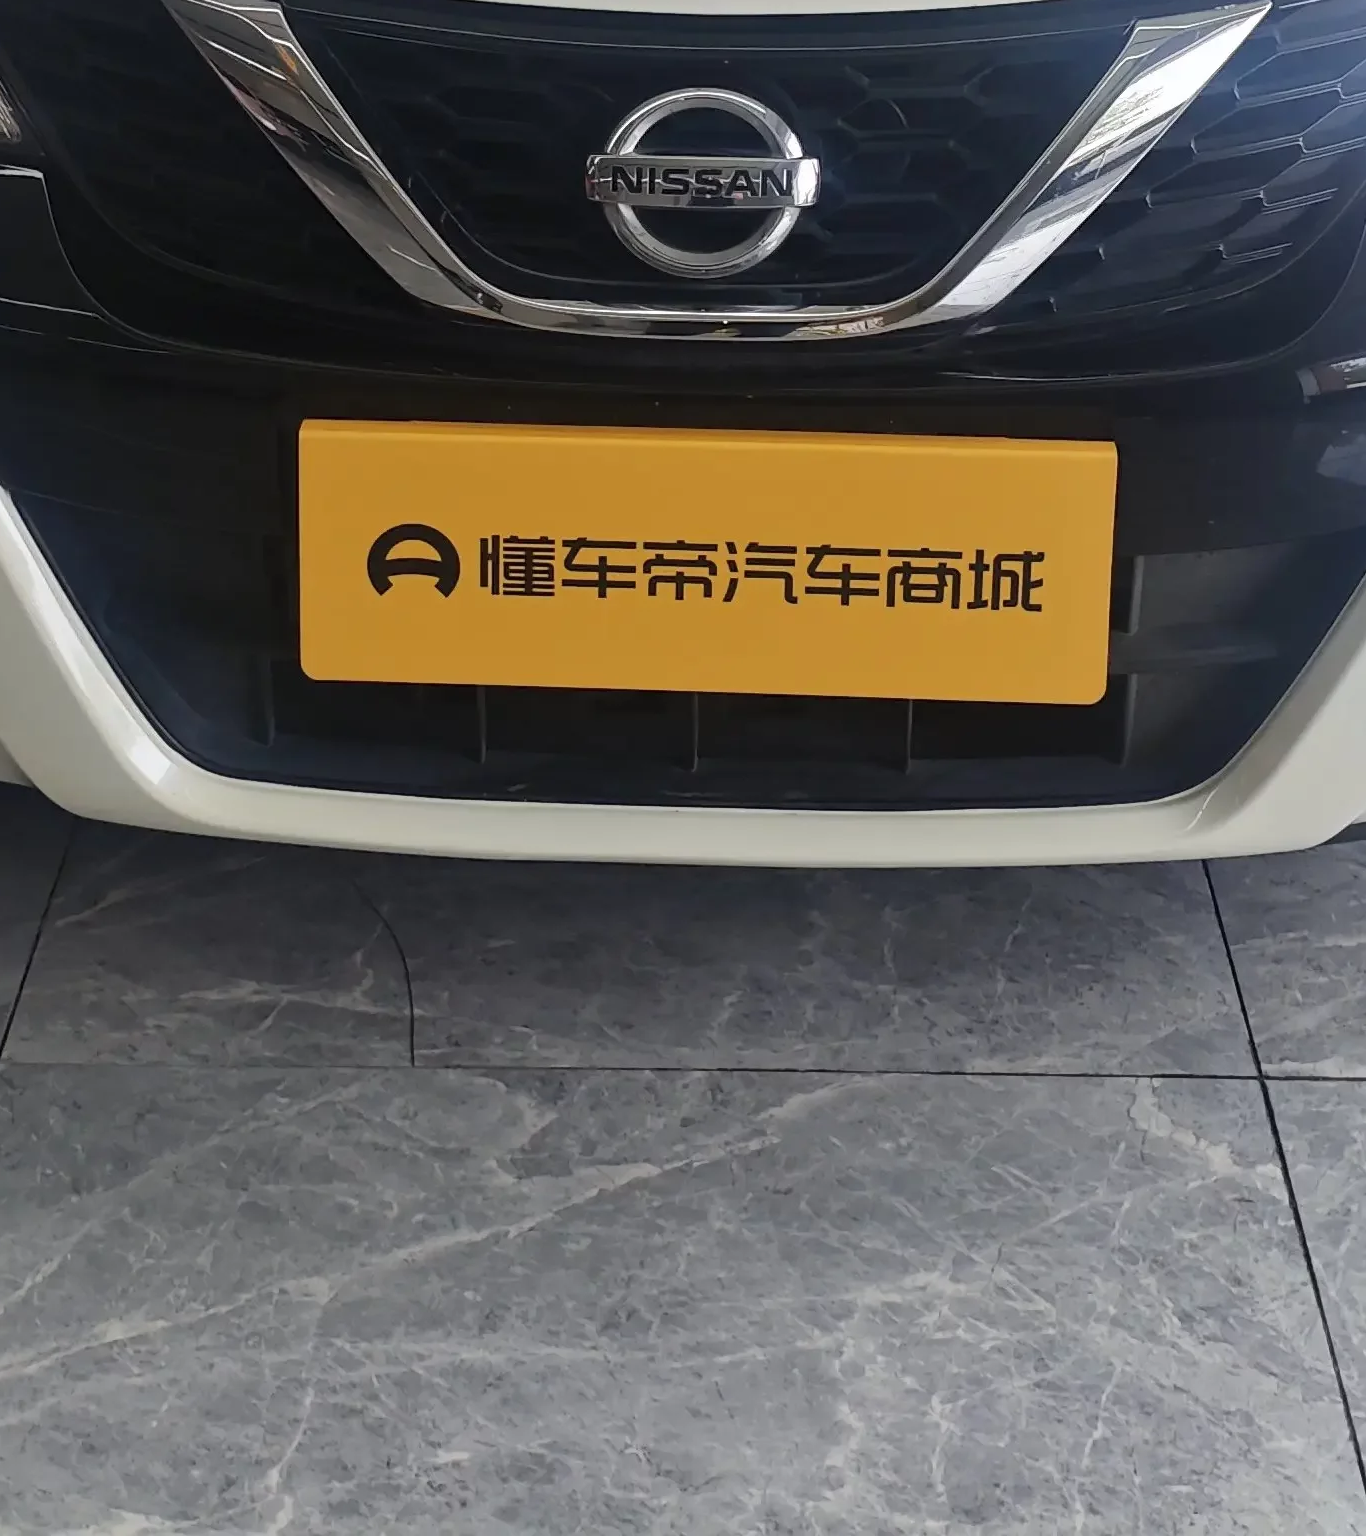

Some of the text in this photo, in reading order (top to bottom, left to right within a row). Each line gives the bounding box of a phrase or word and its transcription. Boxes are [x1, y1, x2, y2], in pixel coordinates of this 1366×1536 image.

[609, 165, 793, 199] NISSAN
[479, 533, 1046, 613] 懂车帝汽车商城
